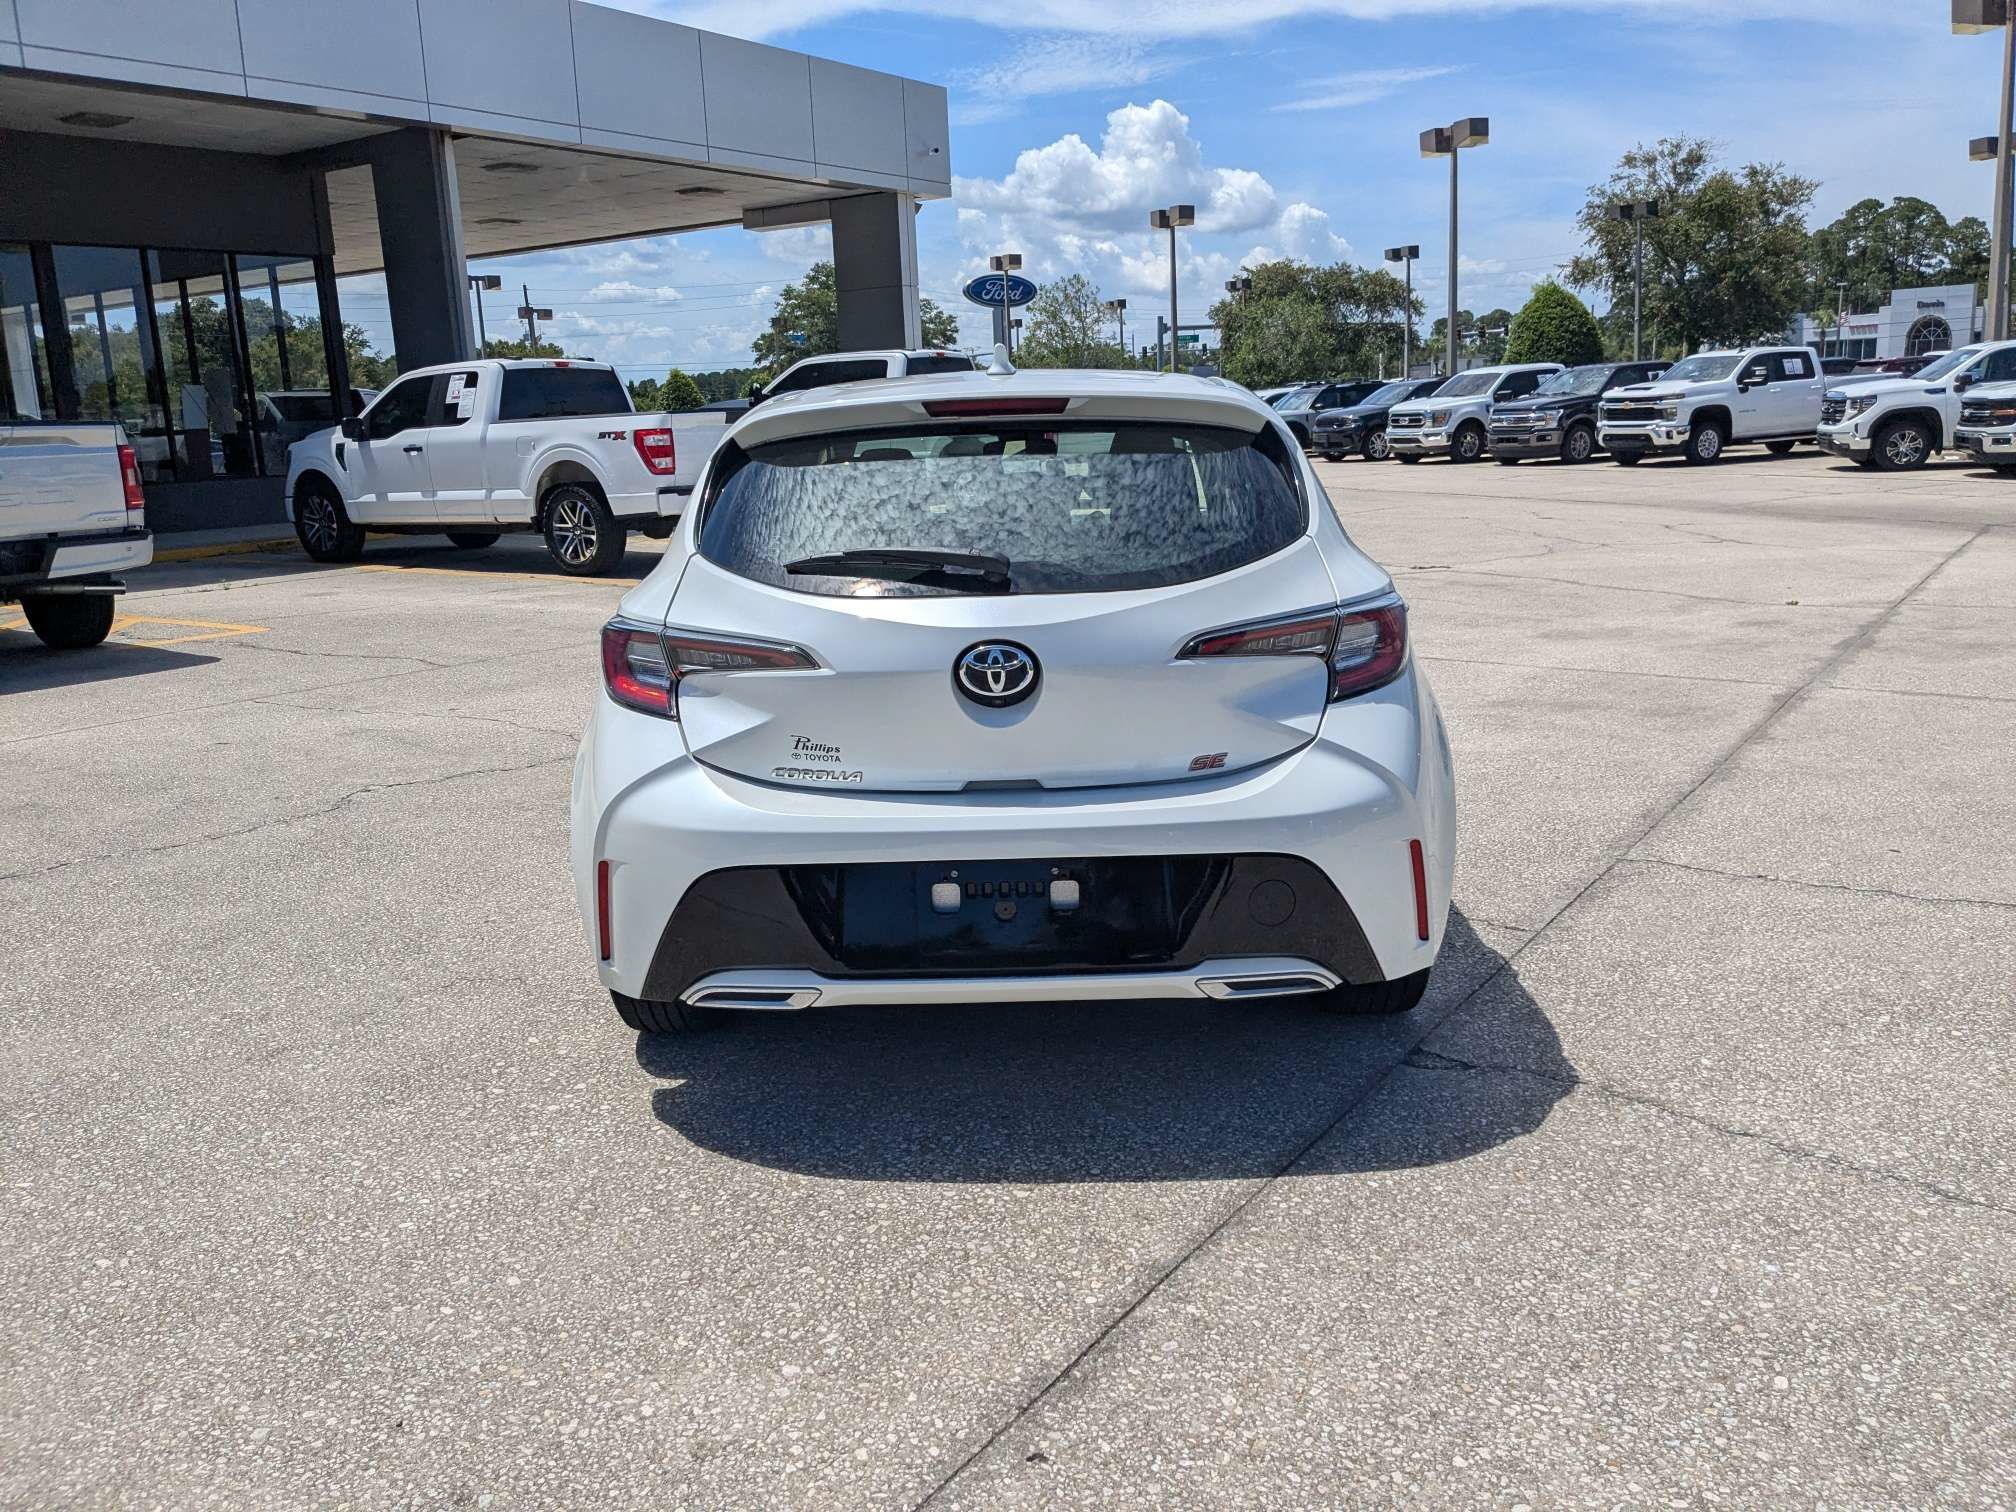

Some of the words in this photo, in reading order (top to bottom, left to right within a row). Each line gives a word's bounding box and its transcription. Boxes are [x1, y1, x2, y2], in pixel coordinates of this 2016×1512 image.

[790, 734, 841, 754] Phillips
[803, 753, 842, 763] TOYOTA
[1188, 752, 1229, 771] SE
[770, 766, 864, 783] COROLLA
